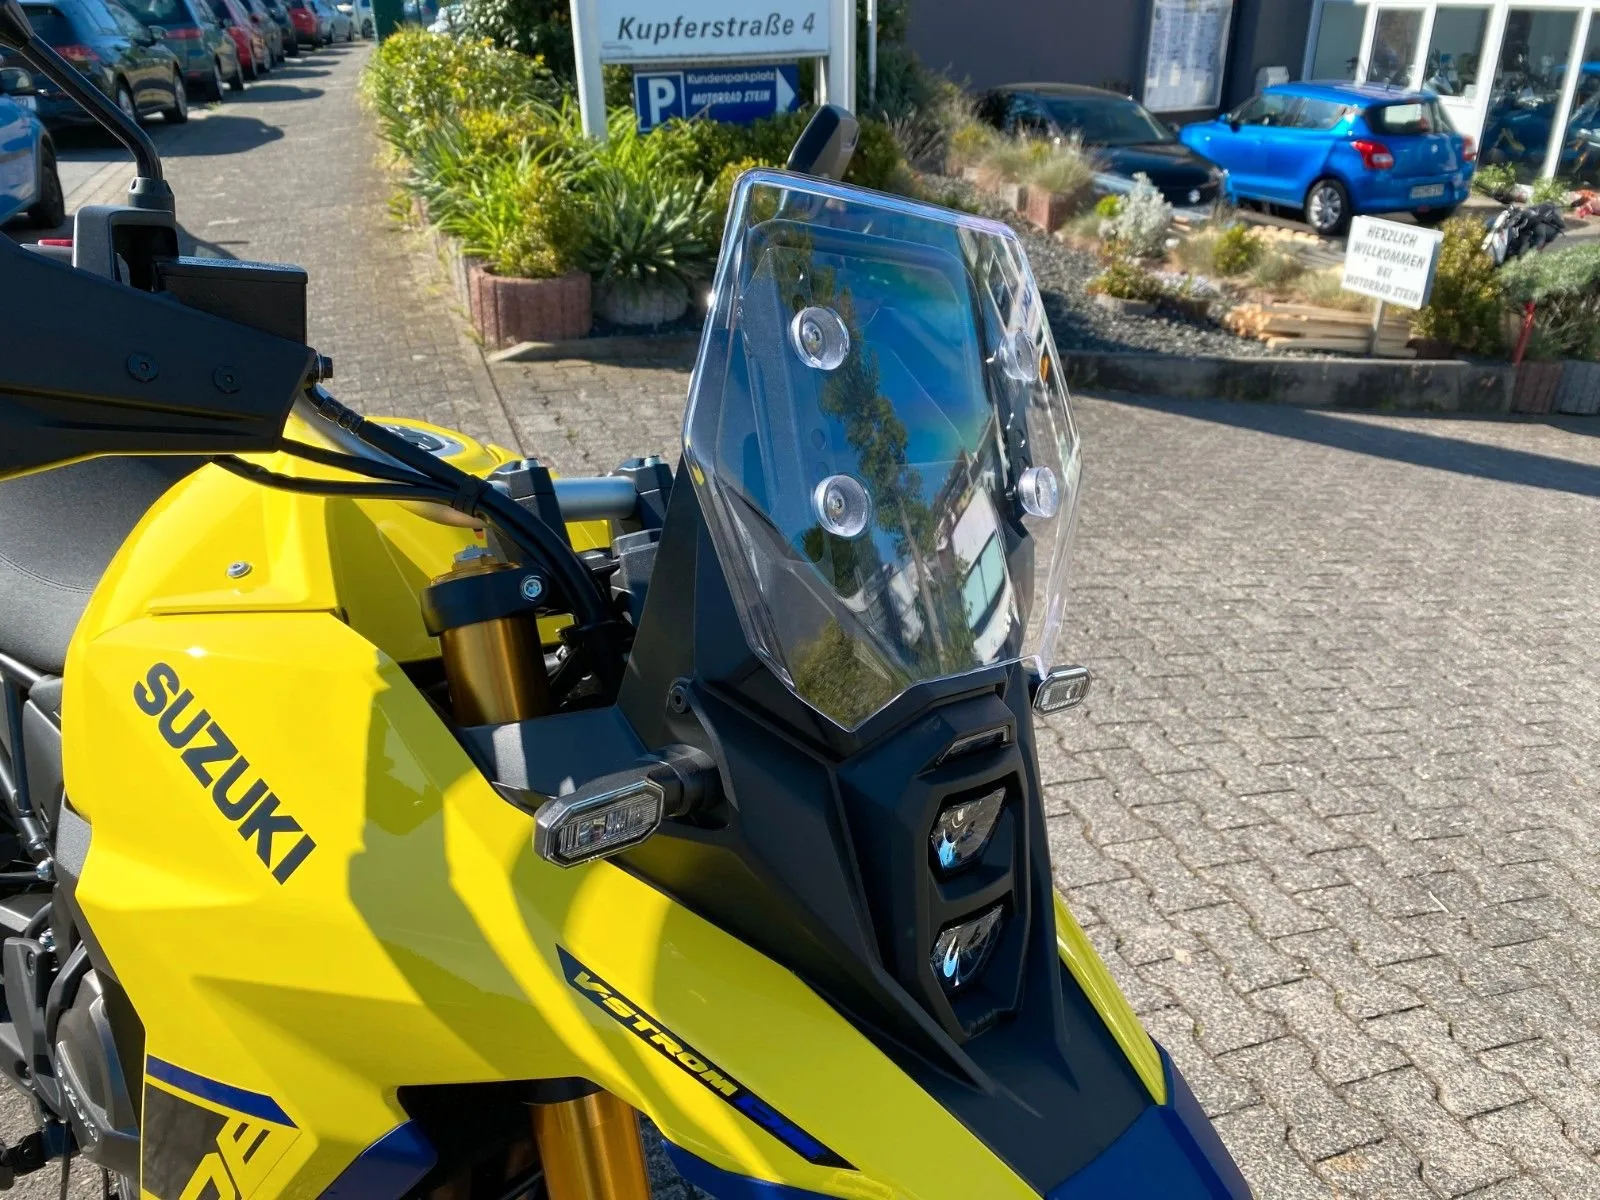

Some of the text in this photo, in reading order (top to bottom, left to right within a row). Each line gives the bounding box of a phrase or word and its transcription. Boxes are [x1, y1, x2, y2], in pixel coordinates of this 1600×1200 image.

[617, 12, 815, 45] Kupferstraße 4
[687, 70, 775, 85] Kundenparkplatz
[648, 78, 676, 126] P
[691, 89, 771, 105] MOTORRAD STEIN
[1367, 225, 1418, 248] HERZLICH
[1353, 241, 1426, 269] WILLKOMMEN
[1377, 266, 1393, 280] BEI
[1345, 274, 1421, 302] MOTORRAD STEIN
[133, 662, 317, 886] SUZUKI
[574, 971, 738, 1097] V-STROM
